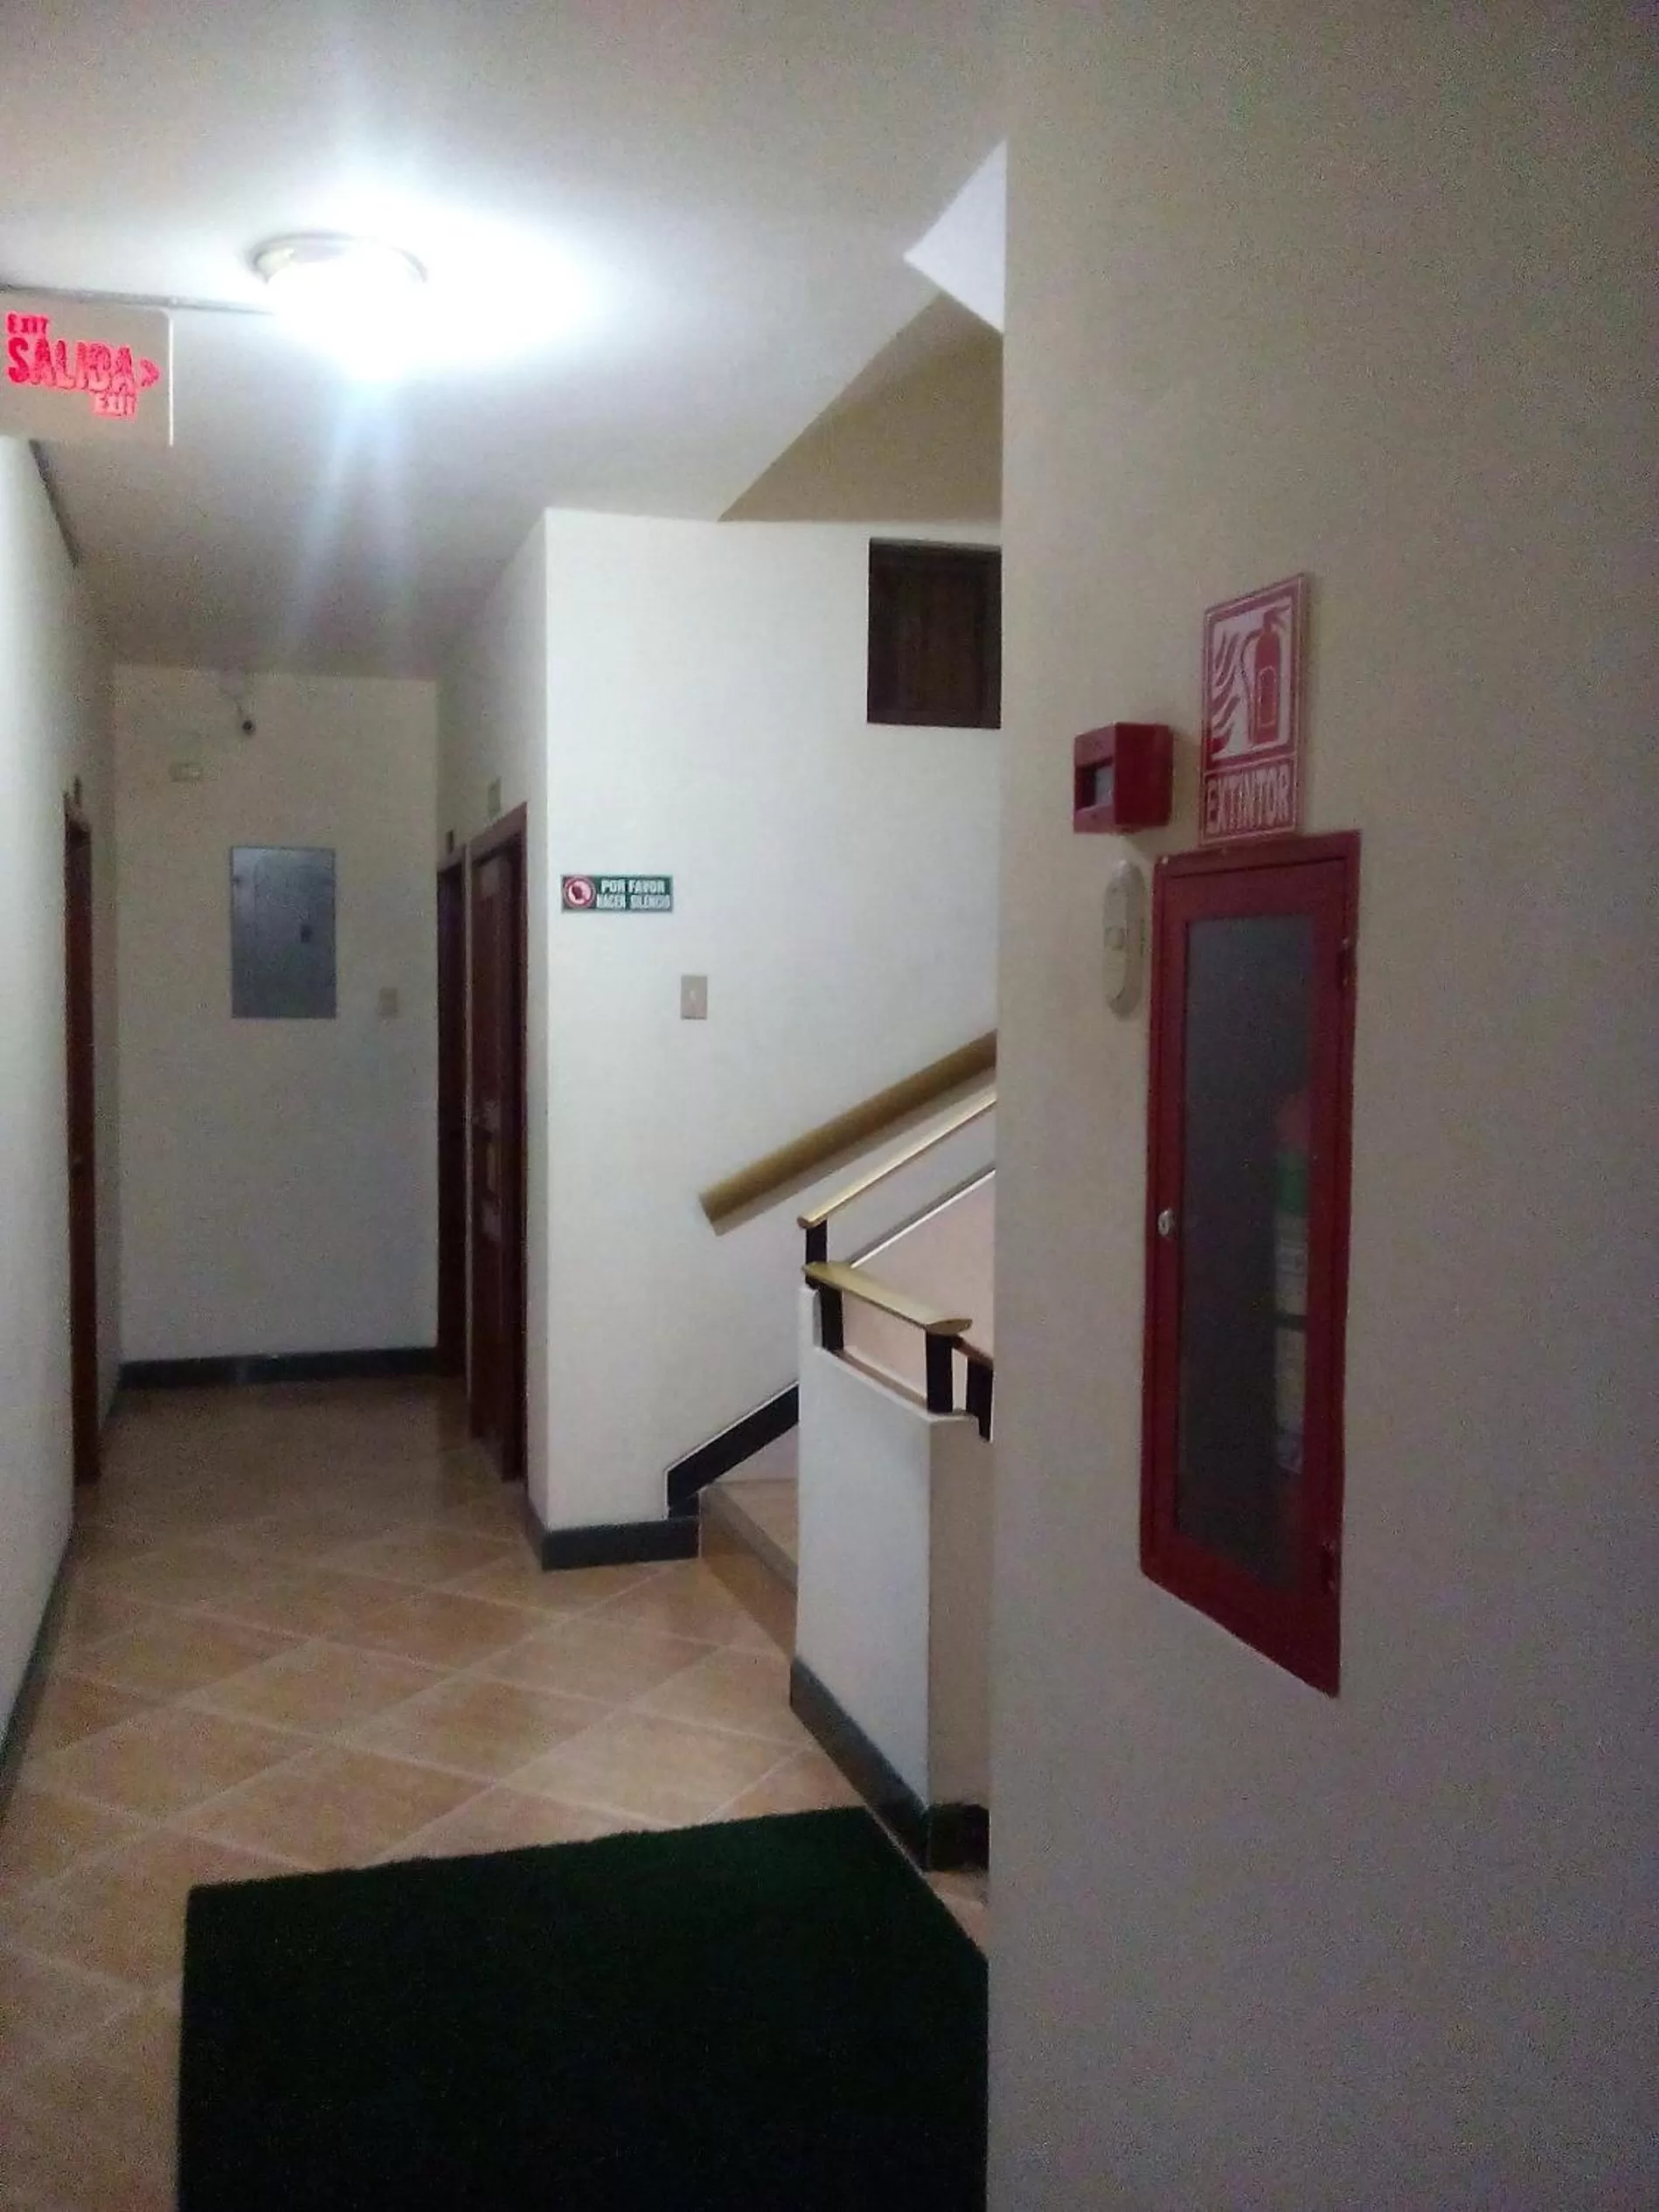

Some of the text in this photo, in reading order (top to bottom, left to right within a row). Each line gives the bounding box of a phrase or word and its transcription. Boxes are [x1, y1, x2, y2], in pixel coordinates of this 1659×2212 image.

[7, 313, 48, 335] EXIT
[8, 336, 135, 392] SALIDA
[1206, 763, 1290, 834] EXTINTOR
[600, 878, 665, 893] POR FAVOR
[596, 893, 670, 909] HACER SILENCIO
